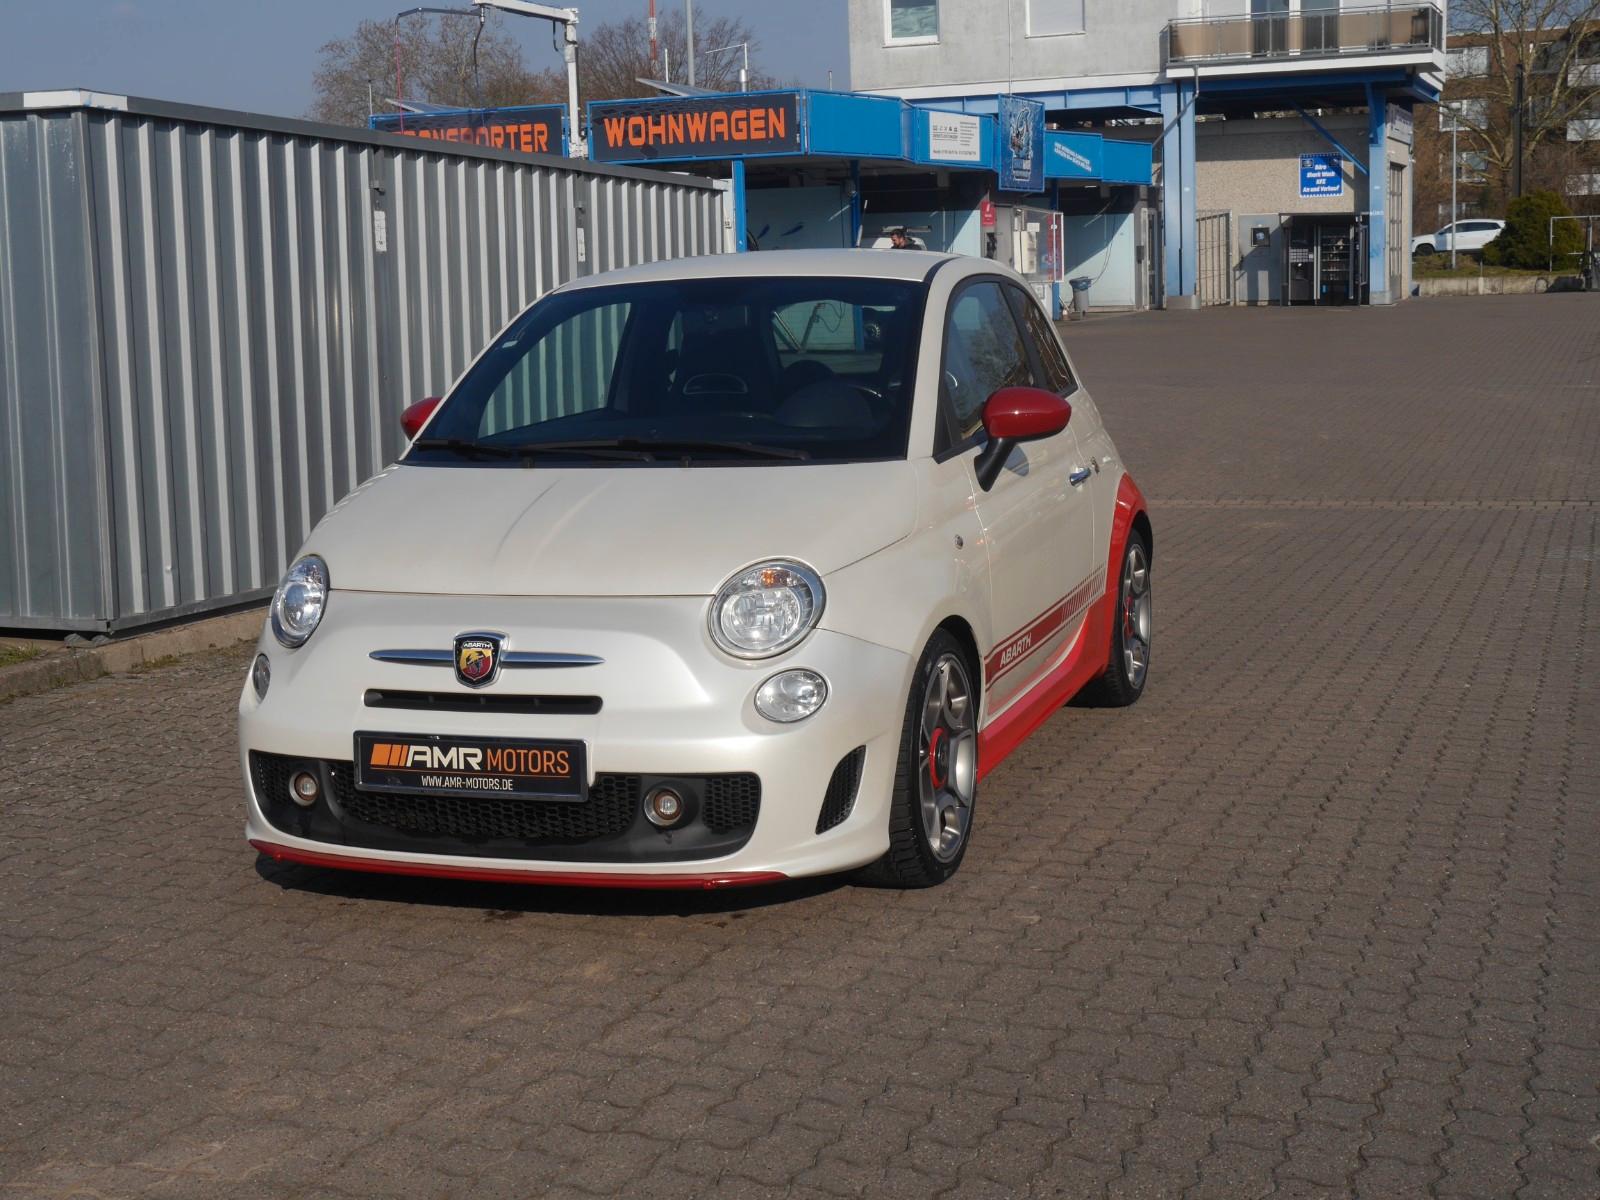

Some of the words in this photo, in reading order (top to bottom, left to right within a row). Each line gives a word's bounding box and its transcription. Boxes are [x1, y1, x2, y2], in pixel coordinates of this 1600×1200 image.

[603, 107, 786, 148] WOHNWAGEN
[1000, 633, 1031, 667] ABARTH
[406, 745, 483, 771] AMR
[487, 748, 570, 774] MOTORS
[421, 775, 514, 791] WWW.AMR-MOTORS.DE
